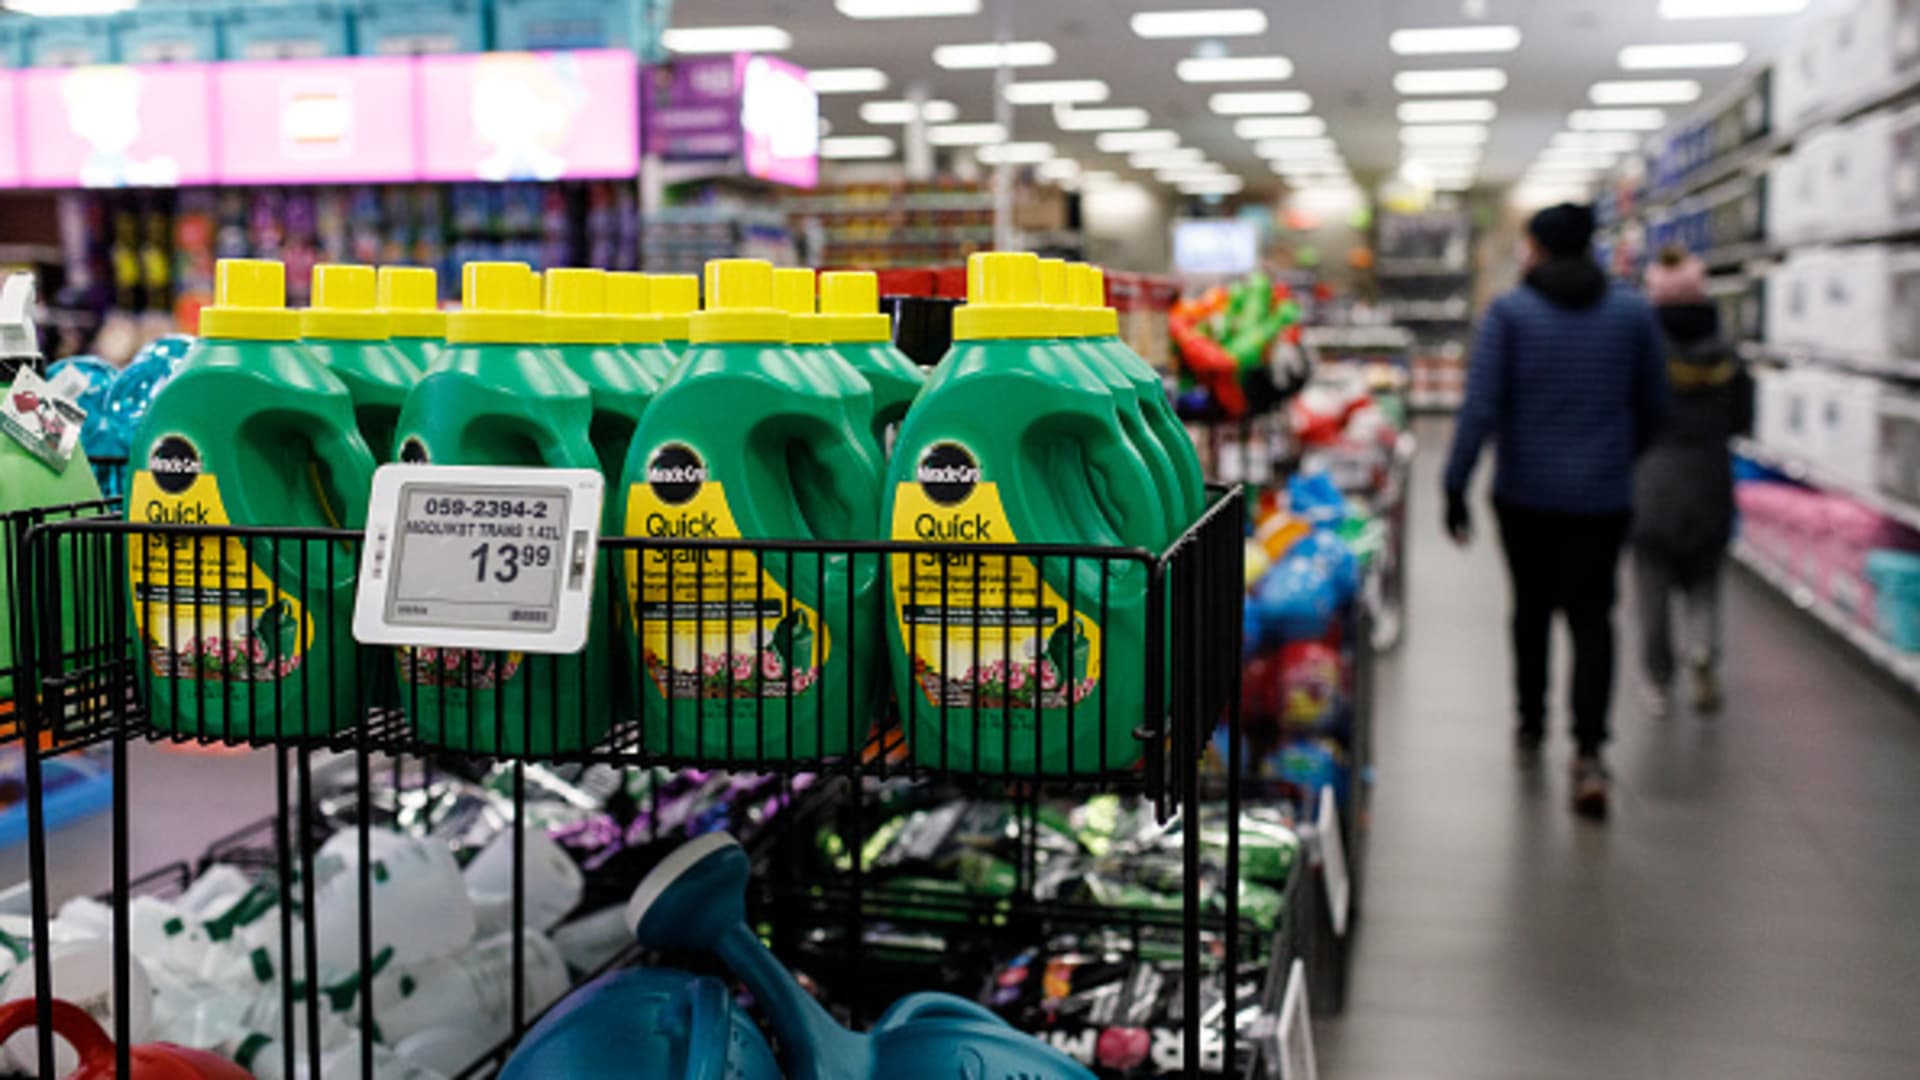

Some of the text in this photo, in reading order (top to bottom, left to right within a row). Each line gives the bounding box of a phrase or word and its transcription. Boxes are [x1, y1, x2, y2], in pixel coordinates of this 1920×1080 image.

[145, 500, 209, 525] Quick
[425, 498, 548, 518] 059-2394-2
[646, 512, 718, 538] Quick
[915, 513, 990, 540] Quick
